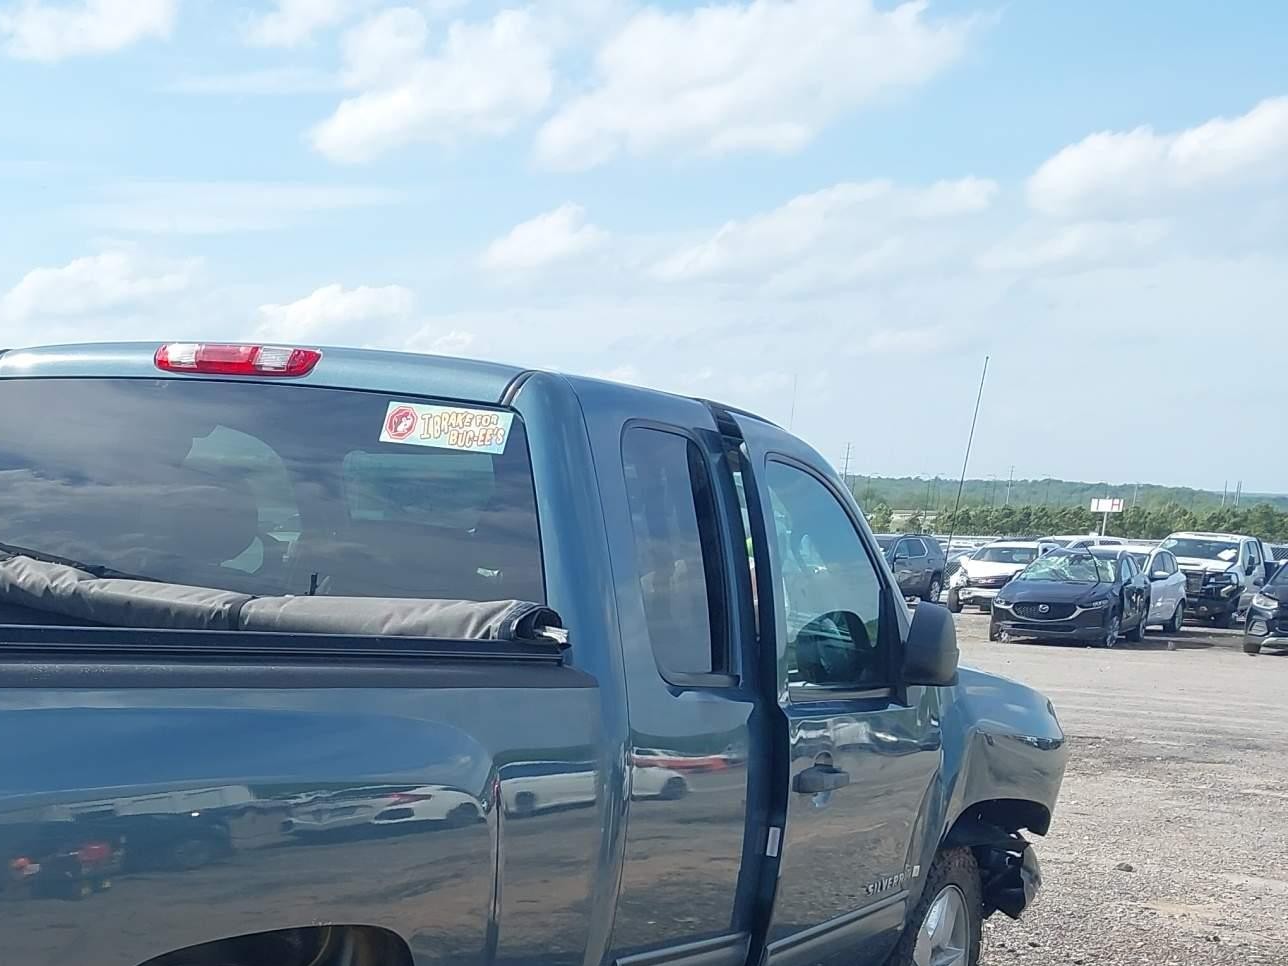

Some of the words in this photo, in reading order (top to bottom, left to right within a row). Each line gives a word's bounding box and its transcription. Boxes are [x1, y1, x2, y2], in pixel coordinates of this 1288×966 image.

[420, 413, 432, 439] I
[432, 411, 474, 439] BRAKE
[475, 414, 499, 428] FOR
